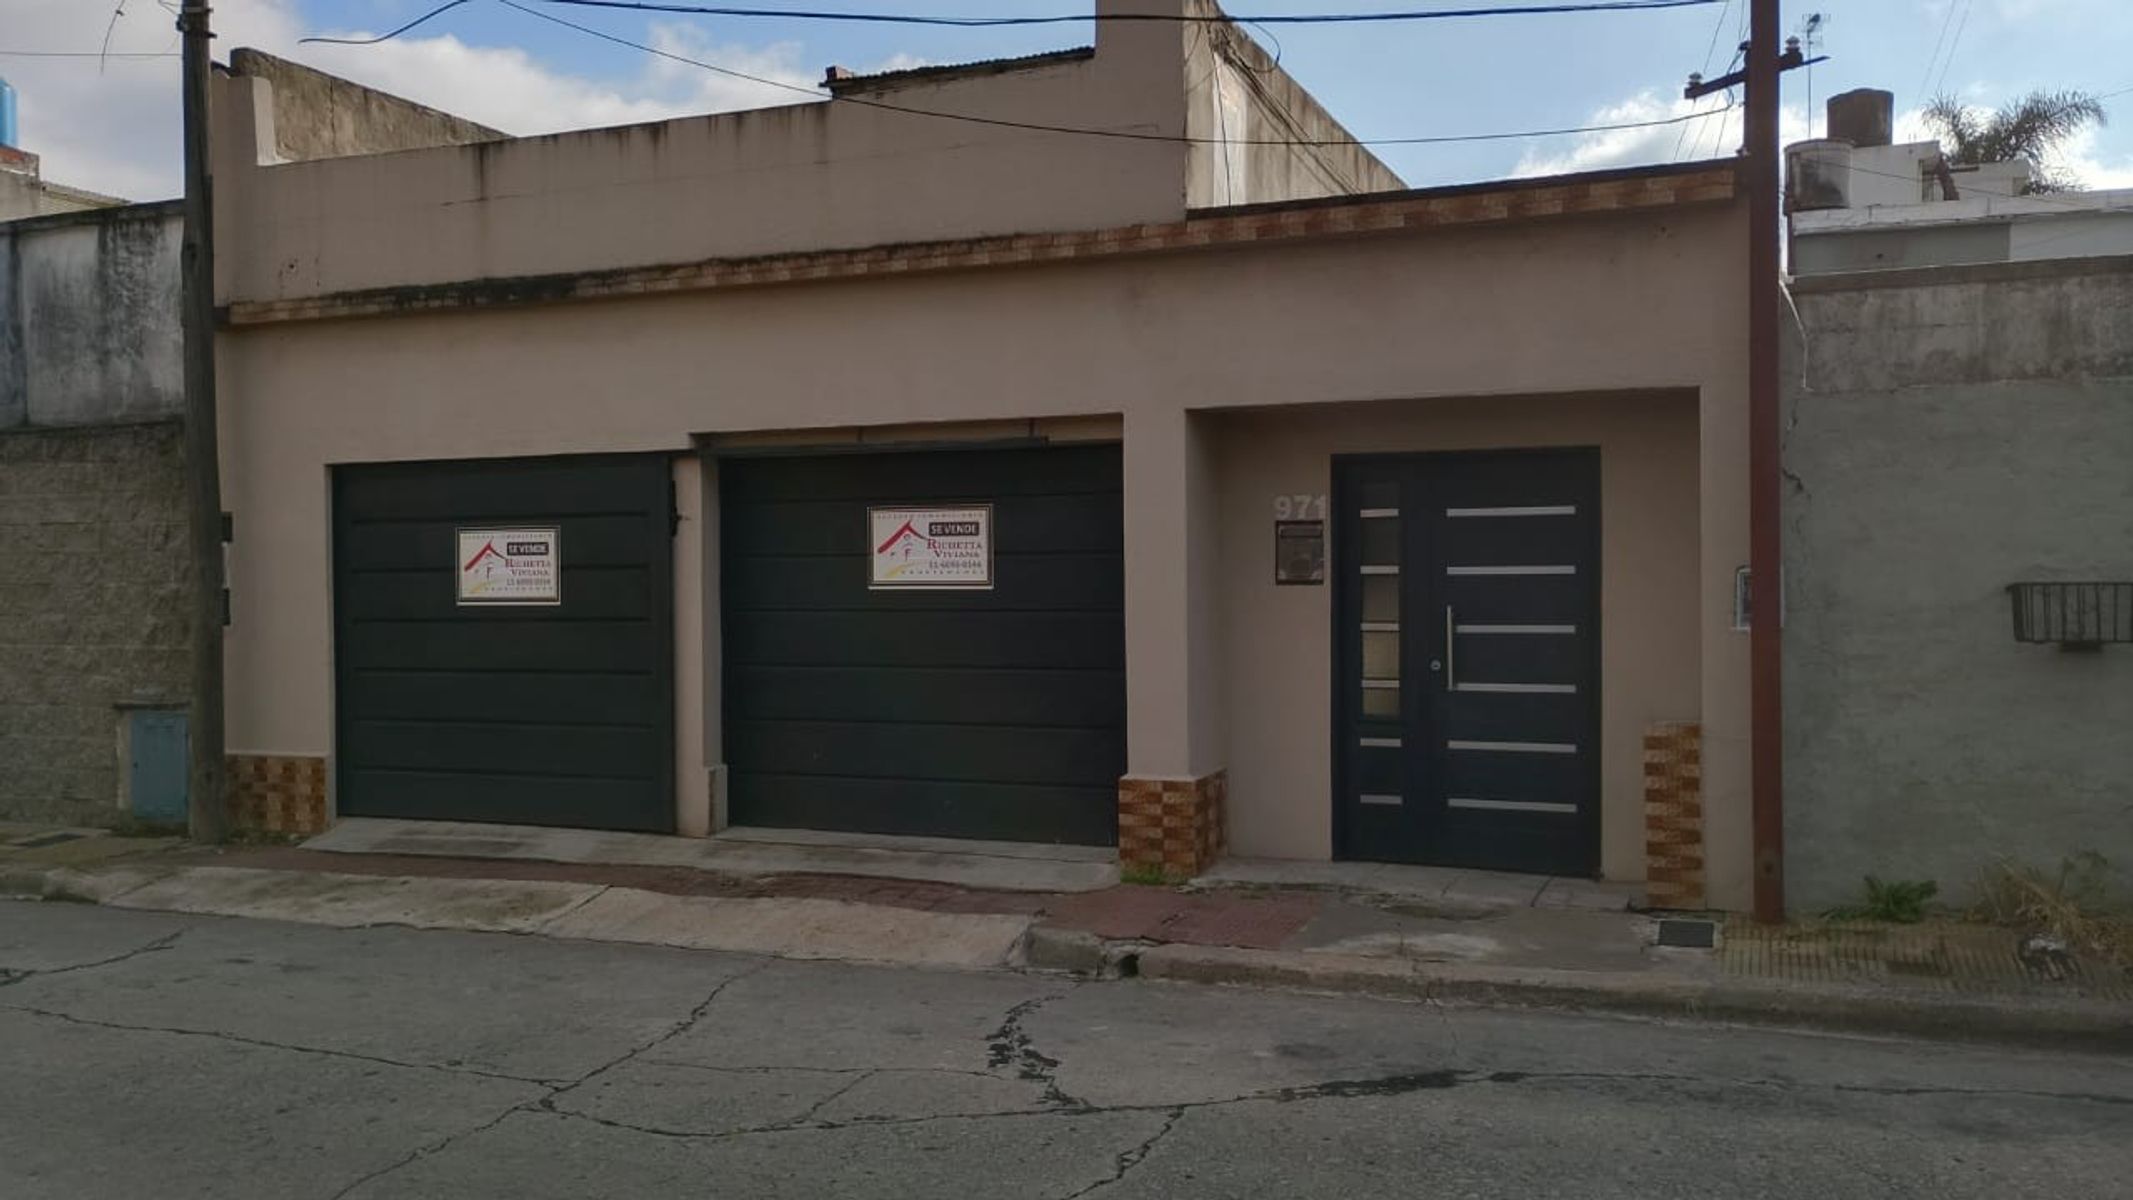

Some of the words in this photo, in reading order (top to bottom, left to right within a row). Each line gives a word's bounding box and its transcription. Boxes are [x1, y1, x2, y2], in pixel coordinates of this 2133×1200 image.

[1274, 495, 1326, 520] 971
[931, 523, 943, 534] SE
[943, 523, 977, 534] VENDE
